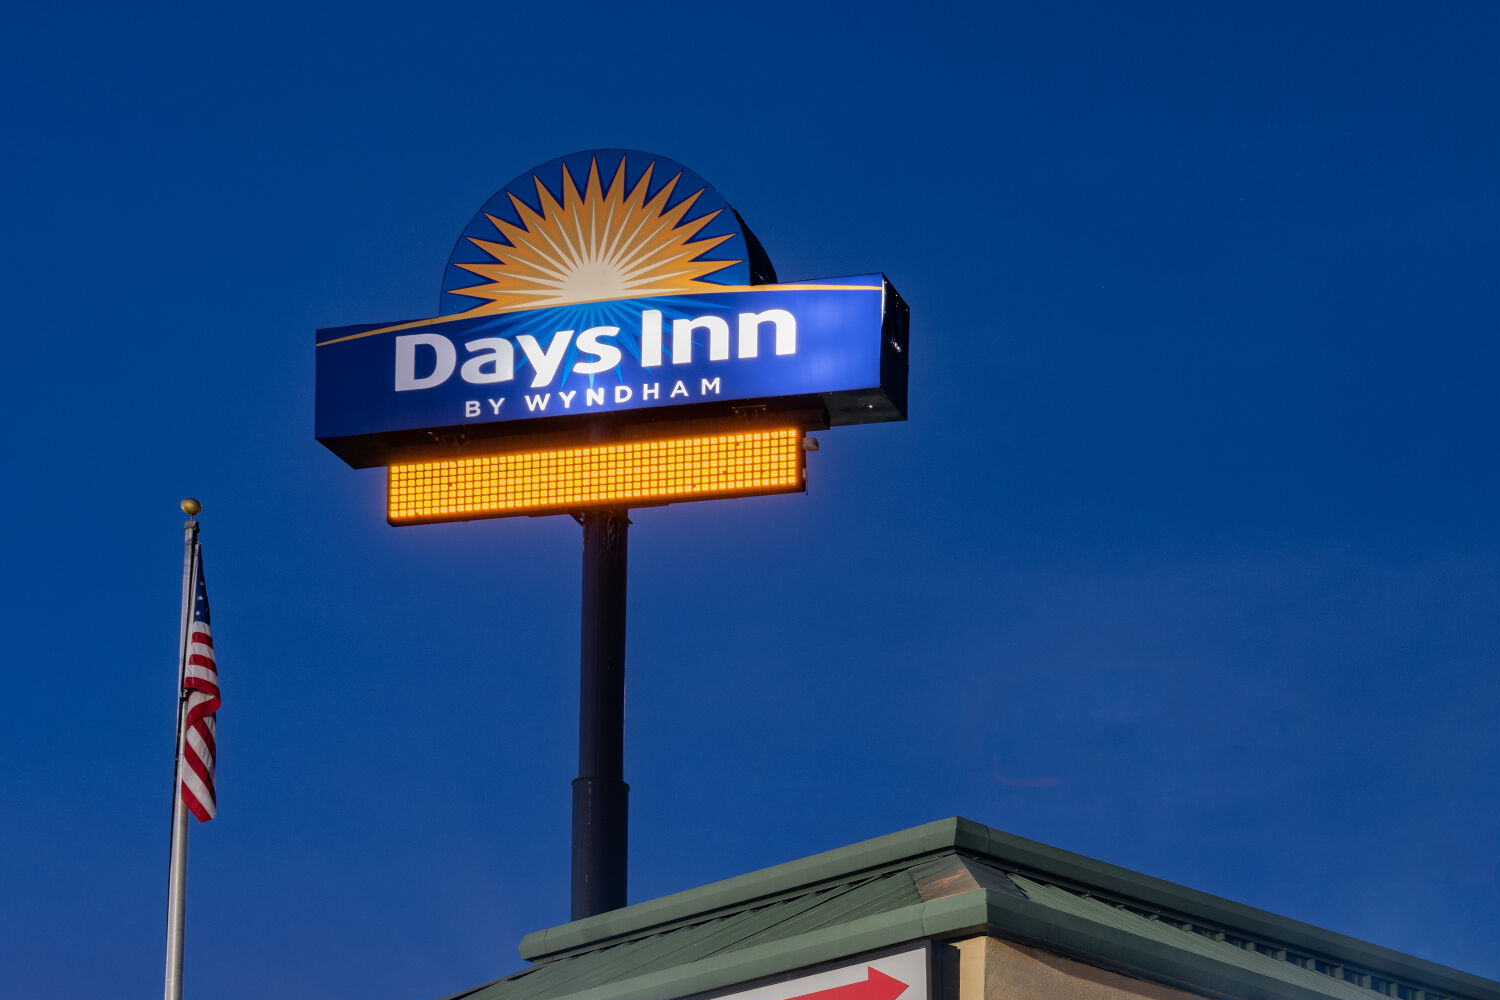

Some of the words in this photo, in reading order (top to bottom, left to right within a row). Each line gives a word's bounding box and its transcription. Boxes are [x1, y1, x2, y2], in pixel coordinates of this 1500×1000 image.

[394, 325, 621, 392] Days
[641, 308, 797, 368] Inn
[465, 397, 505, 418] BY
[525, 376, 722, 412] WYNDHAM
